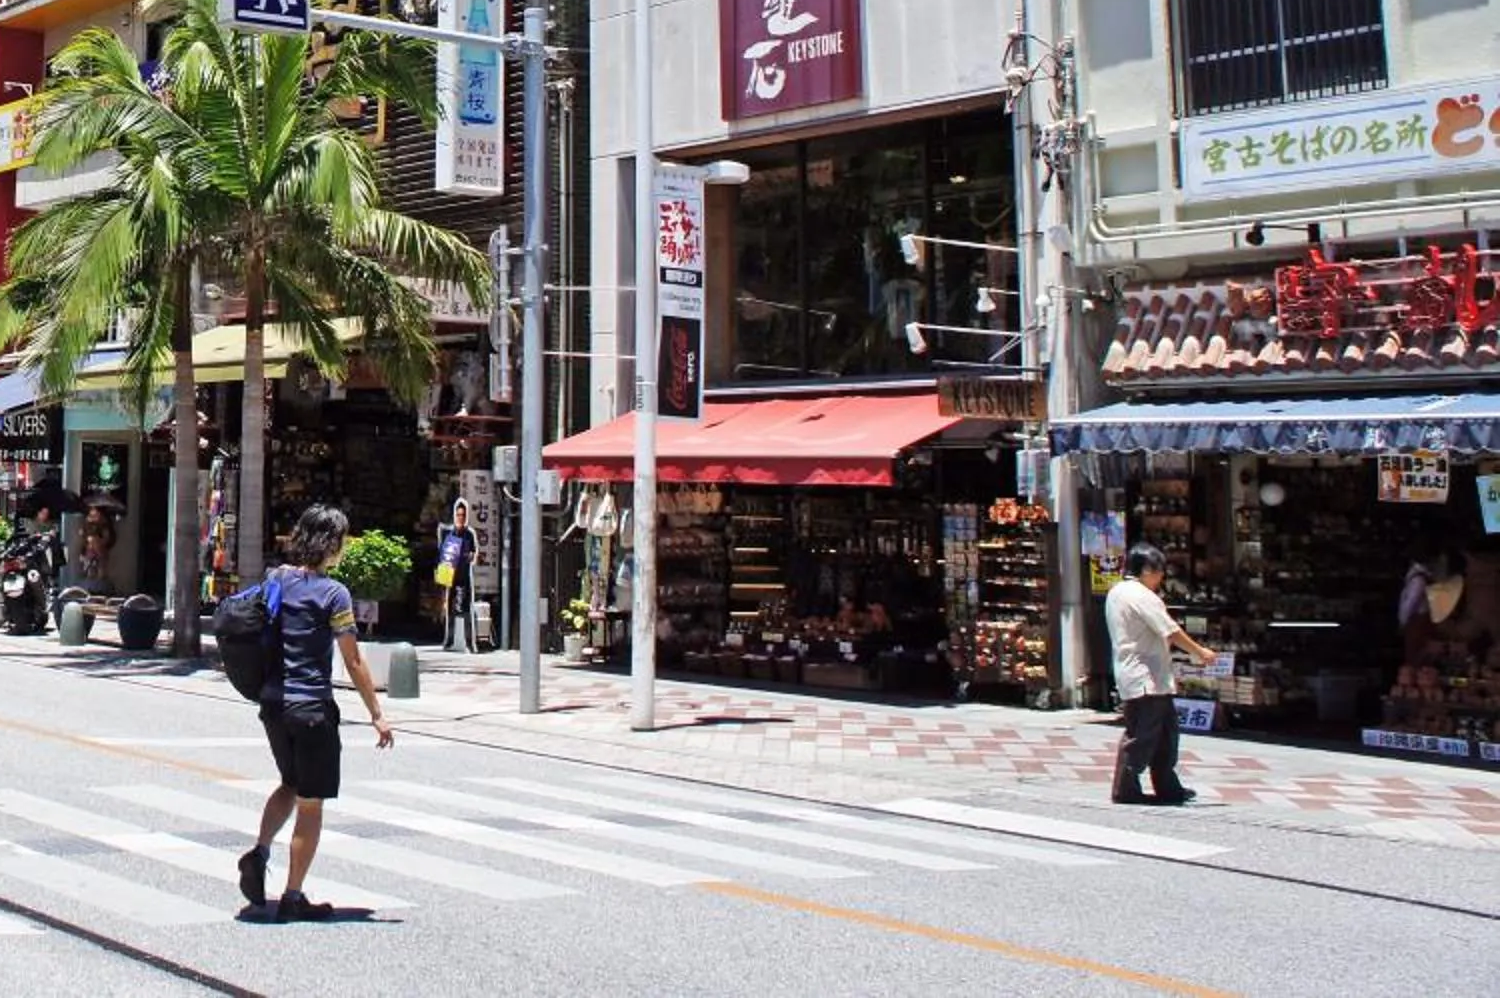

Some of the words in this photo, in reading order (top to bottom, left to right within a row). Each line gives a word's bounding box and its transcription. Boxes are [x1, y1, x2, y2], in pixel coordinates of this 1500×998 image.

[787, 32, 844, 63] KEYSTONE
[1202, 113, 1428, 173] 宮古そばの名所
[1432, 93, 1500, 158] ど
[3, 413, 47, 436] SILVERS
